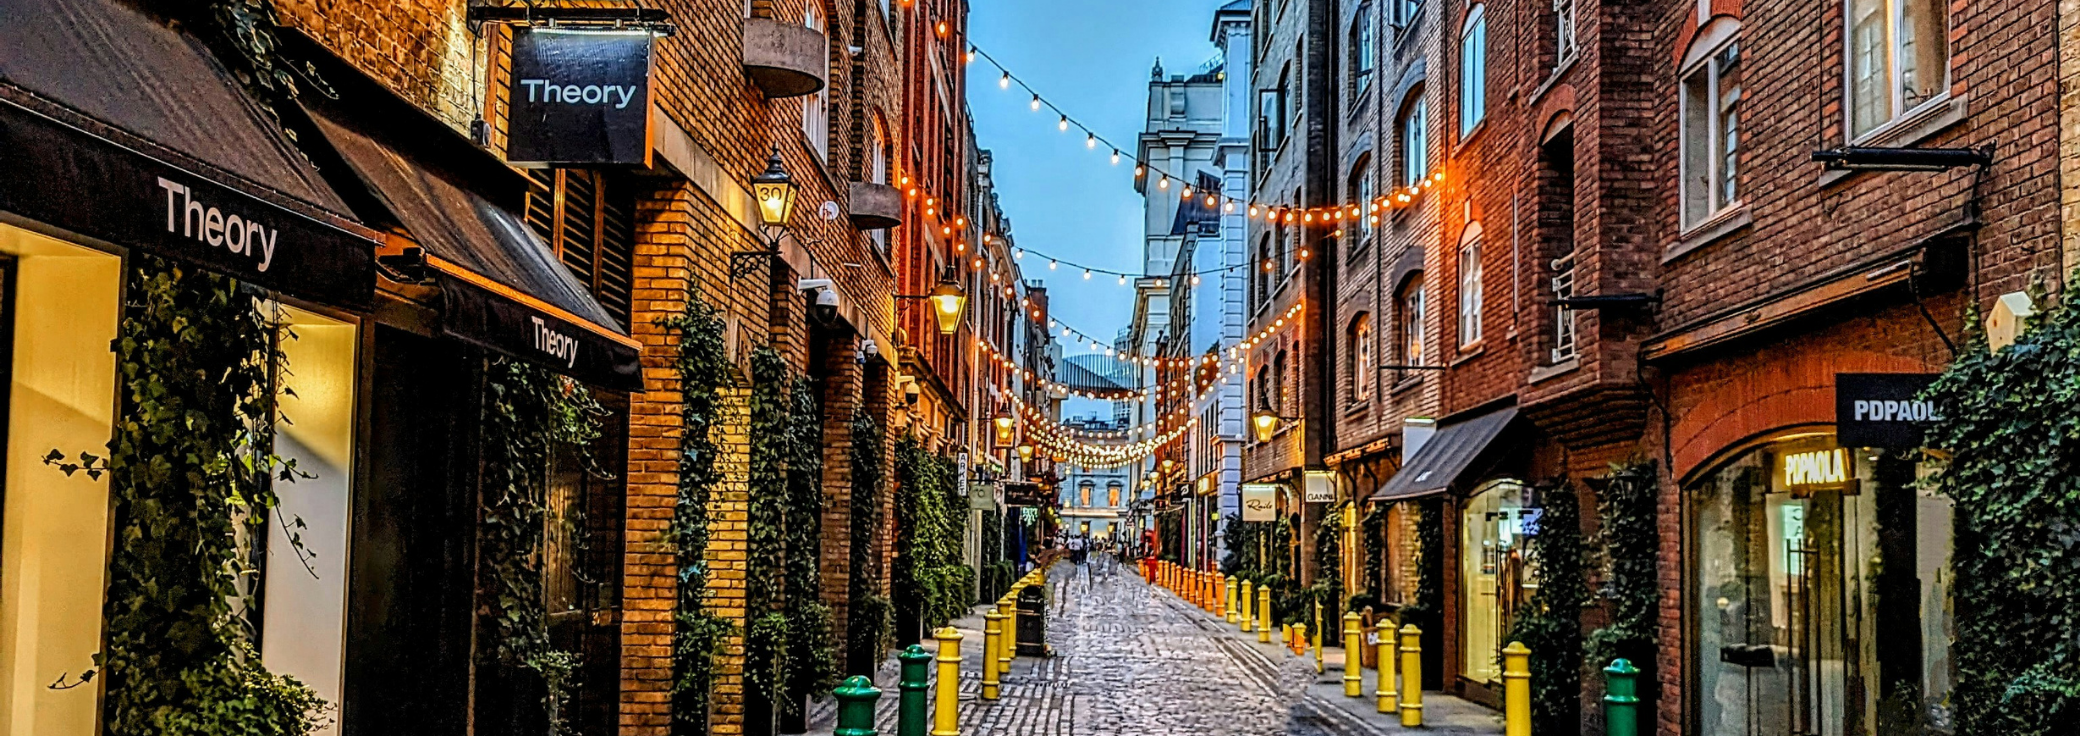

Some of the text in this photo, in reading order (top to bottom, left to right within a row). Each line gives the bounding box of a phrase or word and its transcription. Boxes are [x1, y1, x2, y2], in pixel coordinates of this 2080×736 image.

[520, 79, 636, 109] Theory
[760, 186, 782, 202] 30
[157, 176, 278, 272] Theory
[531, 315, 579, 369] Theory
[1854, 400, 1943, 422] PDPAOL
[1246, 499, 1273, 511] Rails
